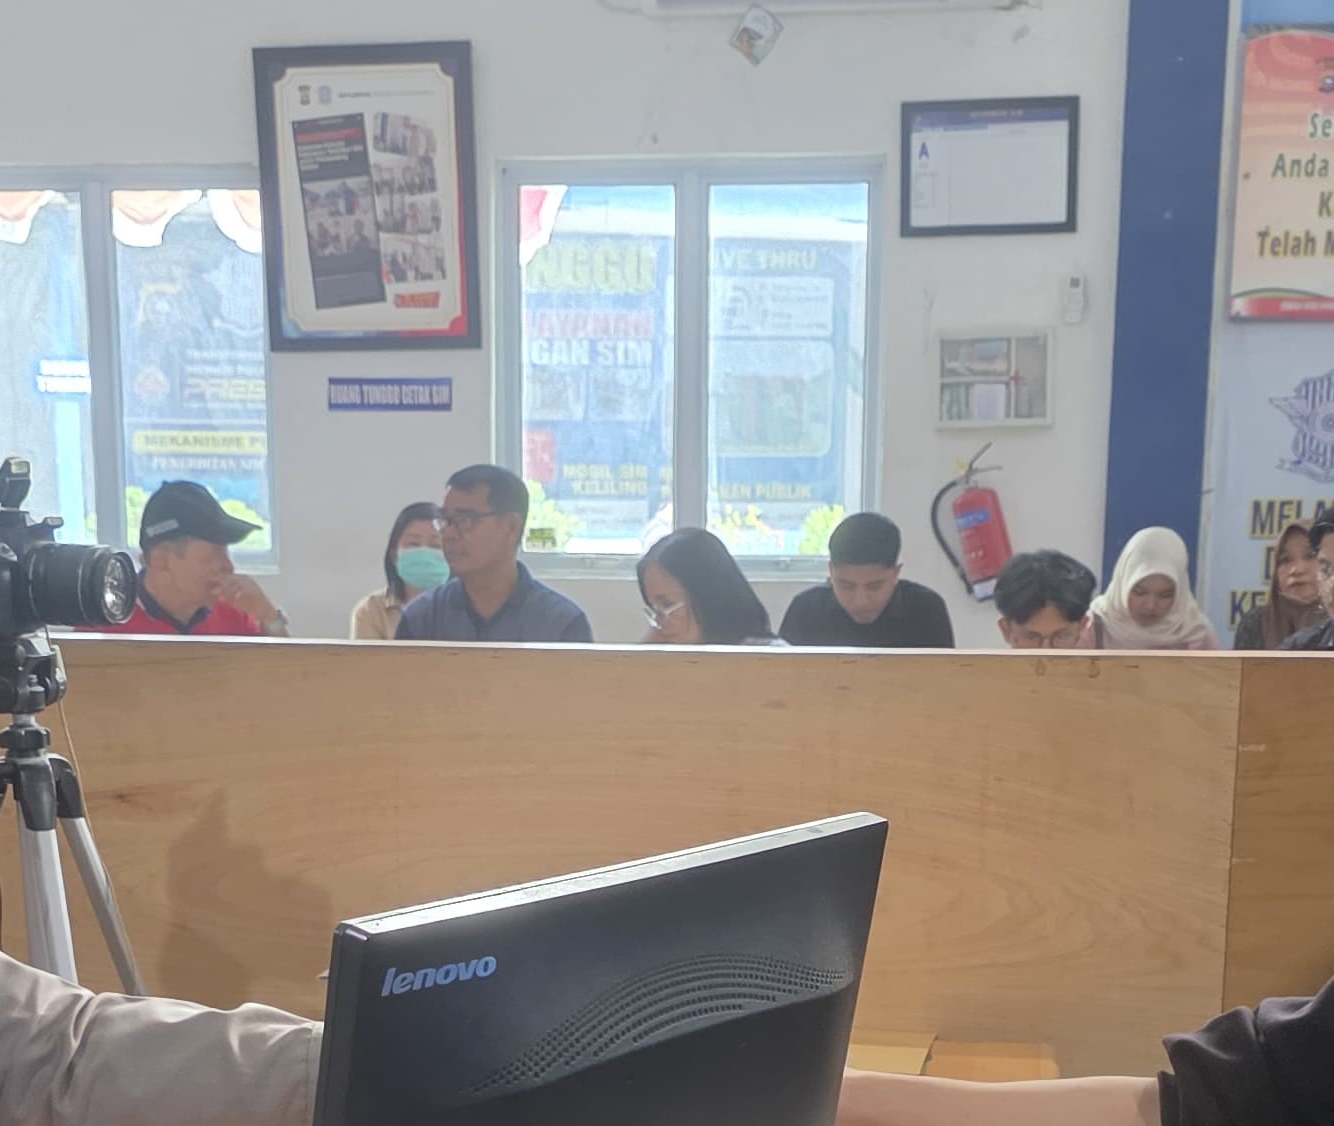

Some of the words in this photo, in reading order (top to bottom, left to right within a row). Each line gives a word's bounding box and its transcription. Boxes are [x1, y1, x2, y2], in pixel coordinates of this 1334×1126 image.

[1271, 152, 1330, 178] Anda
[1257, 229, 1316, 257] Telah
[381, 956, 497, 997] lenovo
